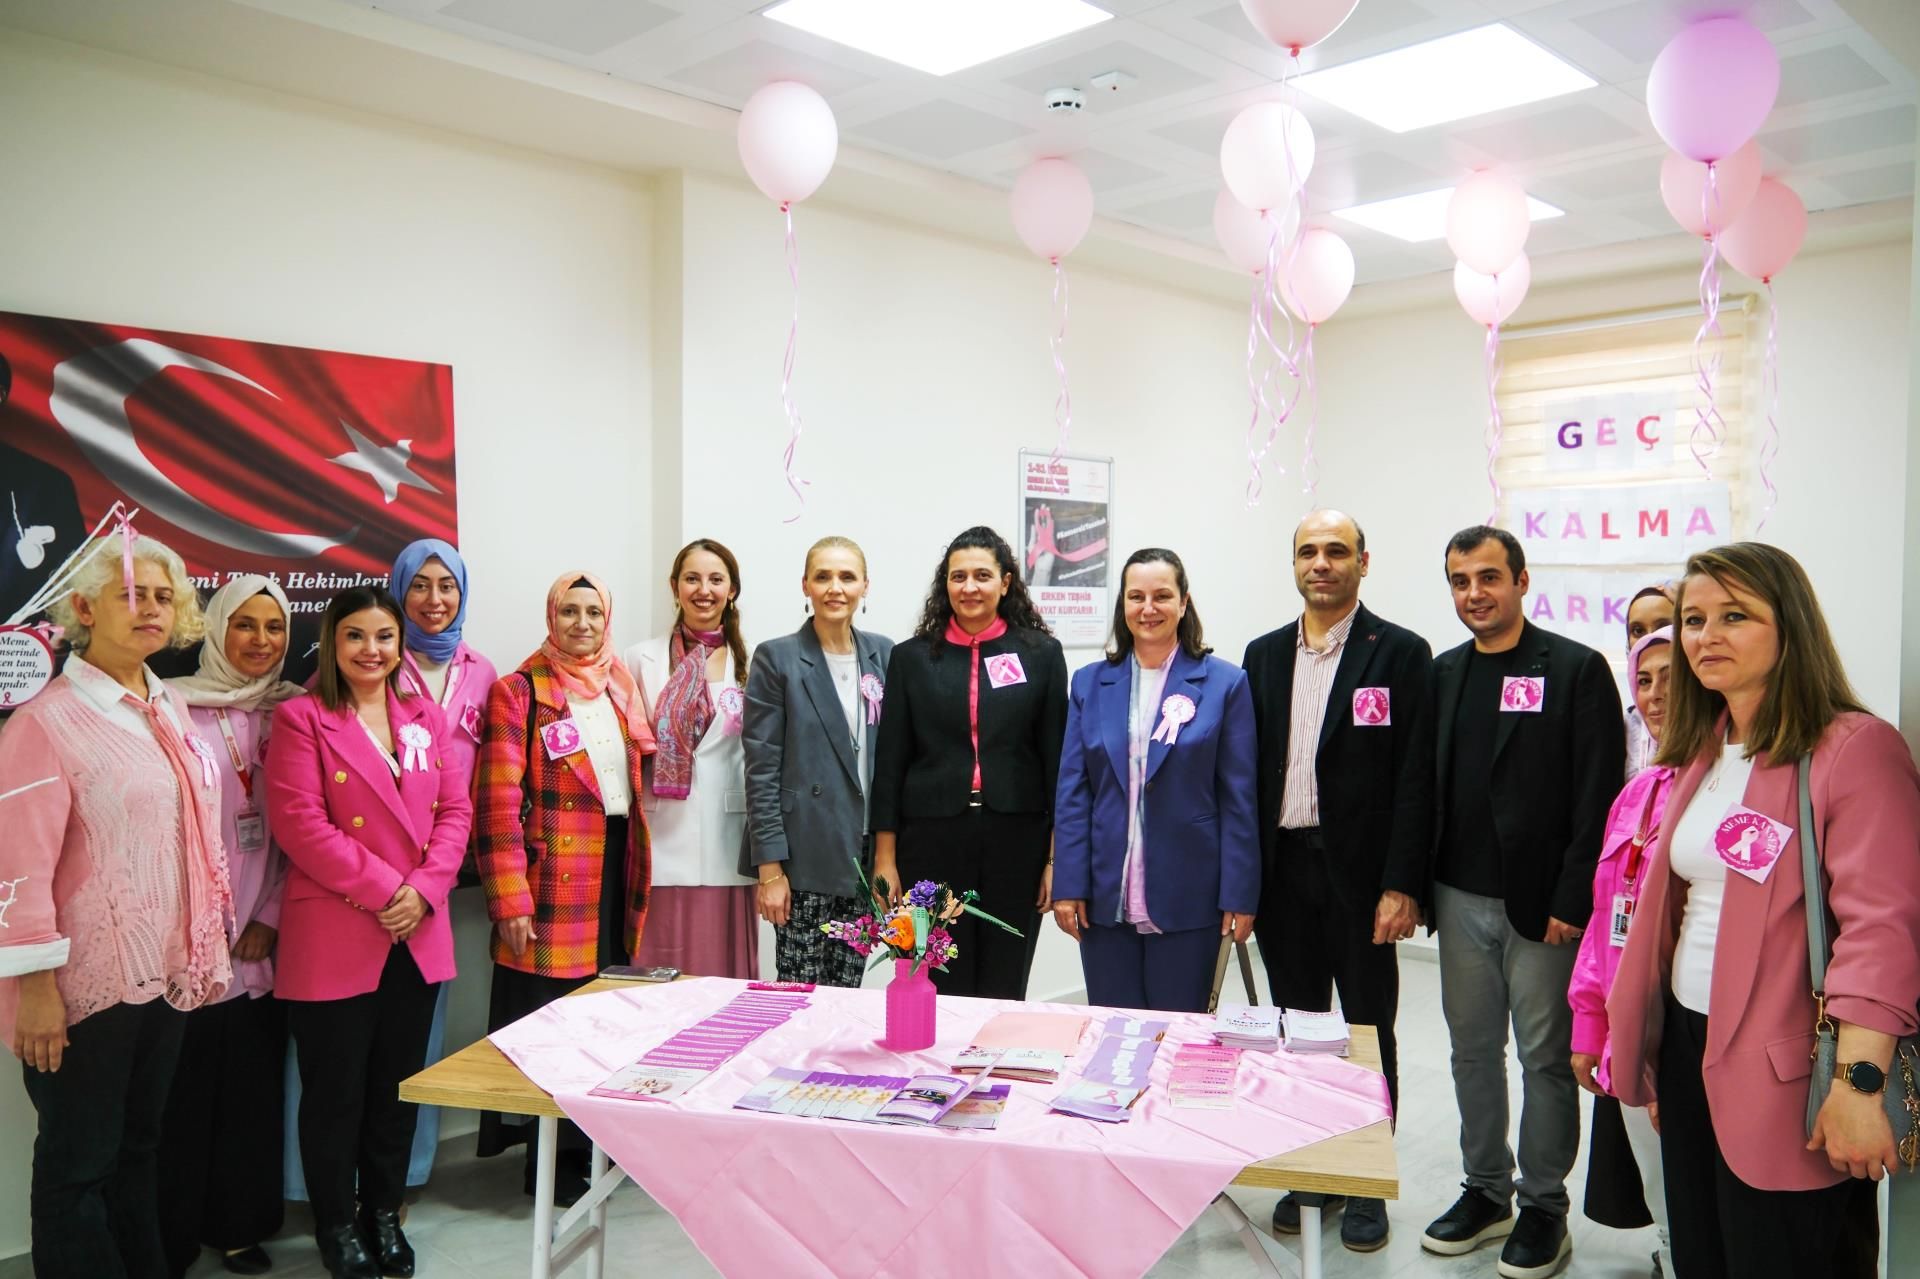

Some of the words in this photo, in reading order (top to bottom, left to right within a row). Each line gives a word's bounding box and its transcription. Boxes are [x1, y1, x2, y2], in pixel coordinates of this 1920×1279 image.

[1557, 415, 1661, 451] GEÇ
[1524, 507, 1716, 540] KALMA
[286, 571, 391, 589] Hekimleri
[1041, 592, 1065, 601] ERKEN
[1058, 606, 1093, 615] KURTARIR
[0, 636, 30, 646] Meme
[0, 660, 13, 668] en
[17, 669, 47, 680] açılan
[1721, 815, 1750, 833] MEME
